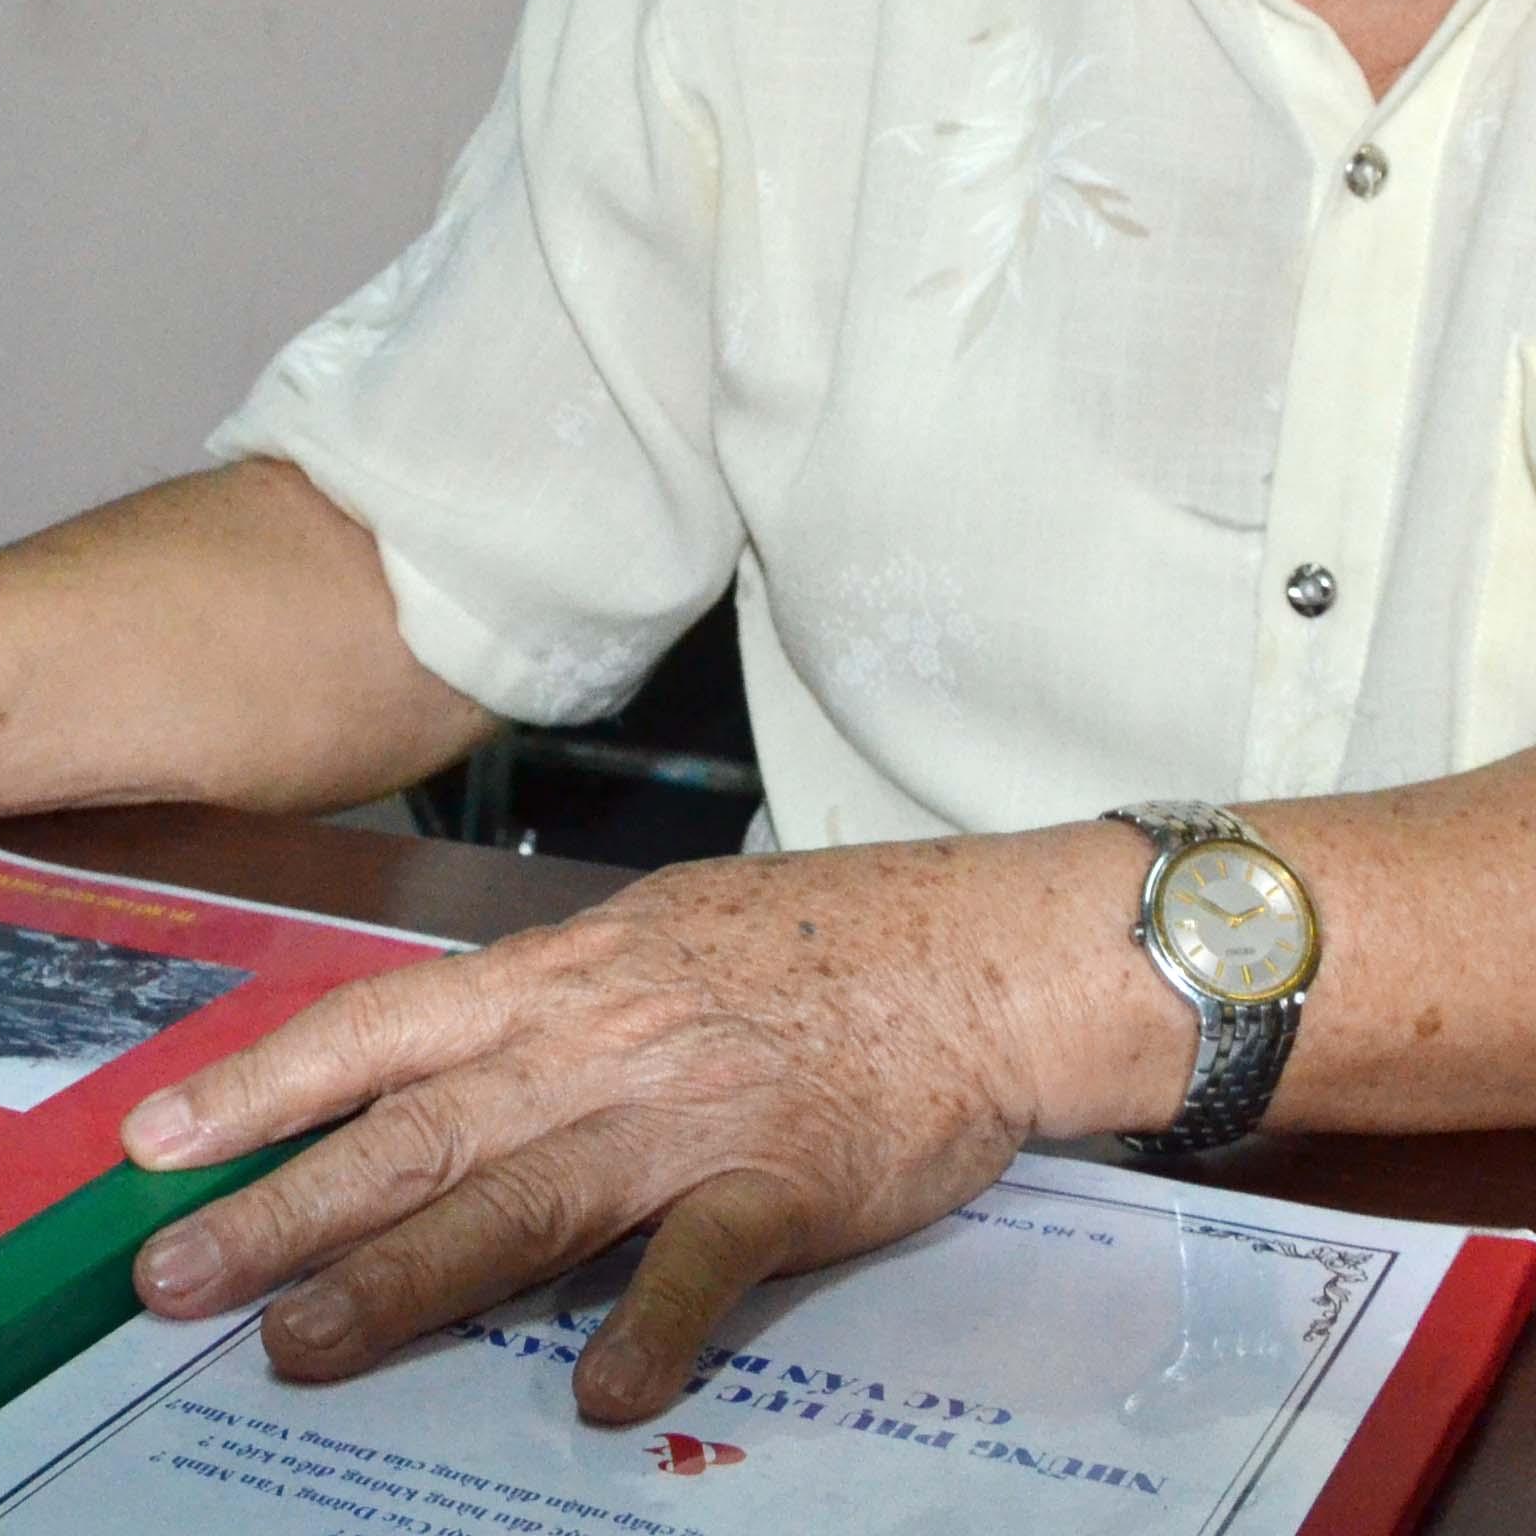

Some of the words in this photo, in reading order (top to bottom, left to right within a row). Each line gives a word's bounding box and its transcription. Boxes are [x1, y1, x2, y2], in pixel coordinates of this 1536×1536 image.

[903, 1392, 1012, 1425] CÁC
[246, 1418, 289, 1441] Văn
[843, 1408, 956, 1450] PHỤ
[221, 1439, 277, 1464] kiện
[171, 1455, 235, 1482] Minh
[429, 1463, 491, 1491] hàng
[969, 1440, 1166, 1495] NHỮNG
[239, 1473, 285, 1497] Văn
[340, 1469, 419, 1502] không
[423, 1491, 489, 1520] hàng
[545, 1496, 609, 1519] nhận
